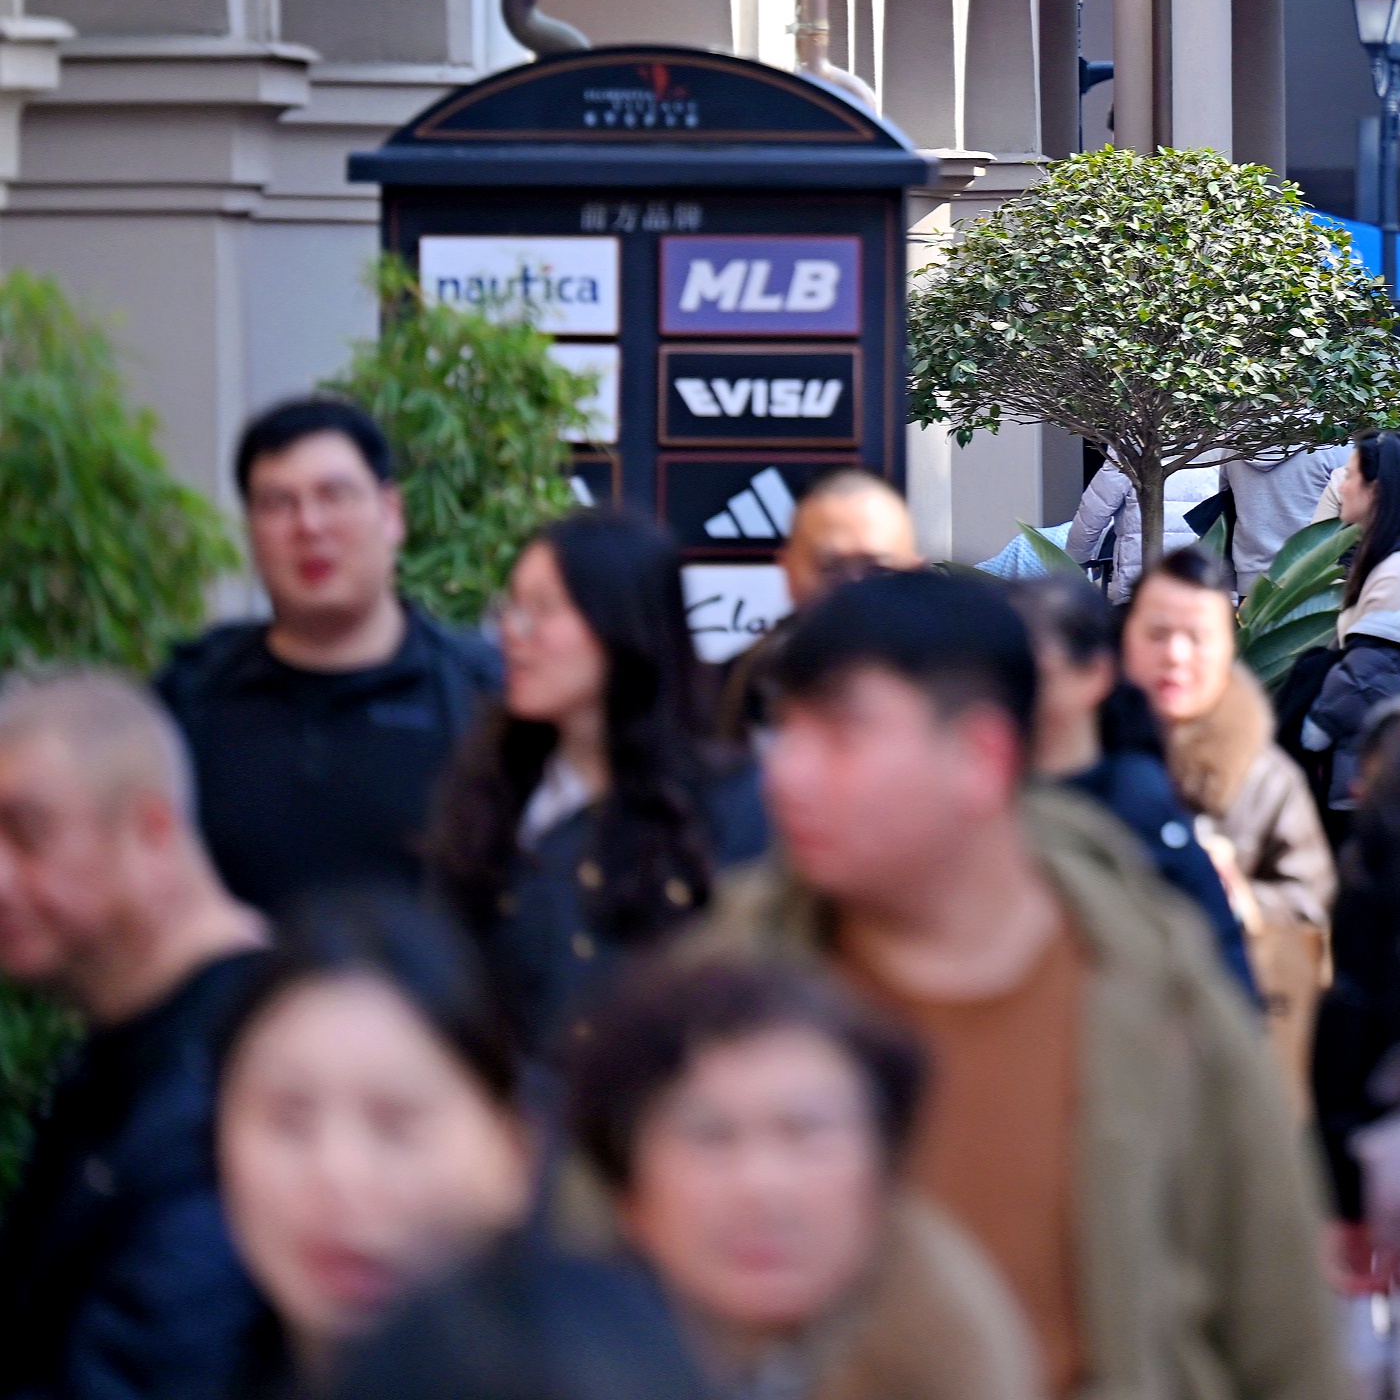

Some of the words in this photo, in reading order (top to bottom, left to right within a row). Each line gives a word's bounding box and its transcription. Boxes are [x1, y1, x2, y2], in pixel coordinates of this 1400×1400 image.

[437, 264, 600, 305] nautica
[680, 260, 840, 313] MLB
[674, 378, 842, 418] EVISU
